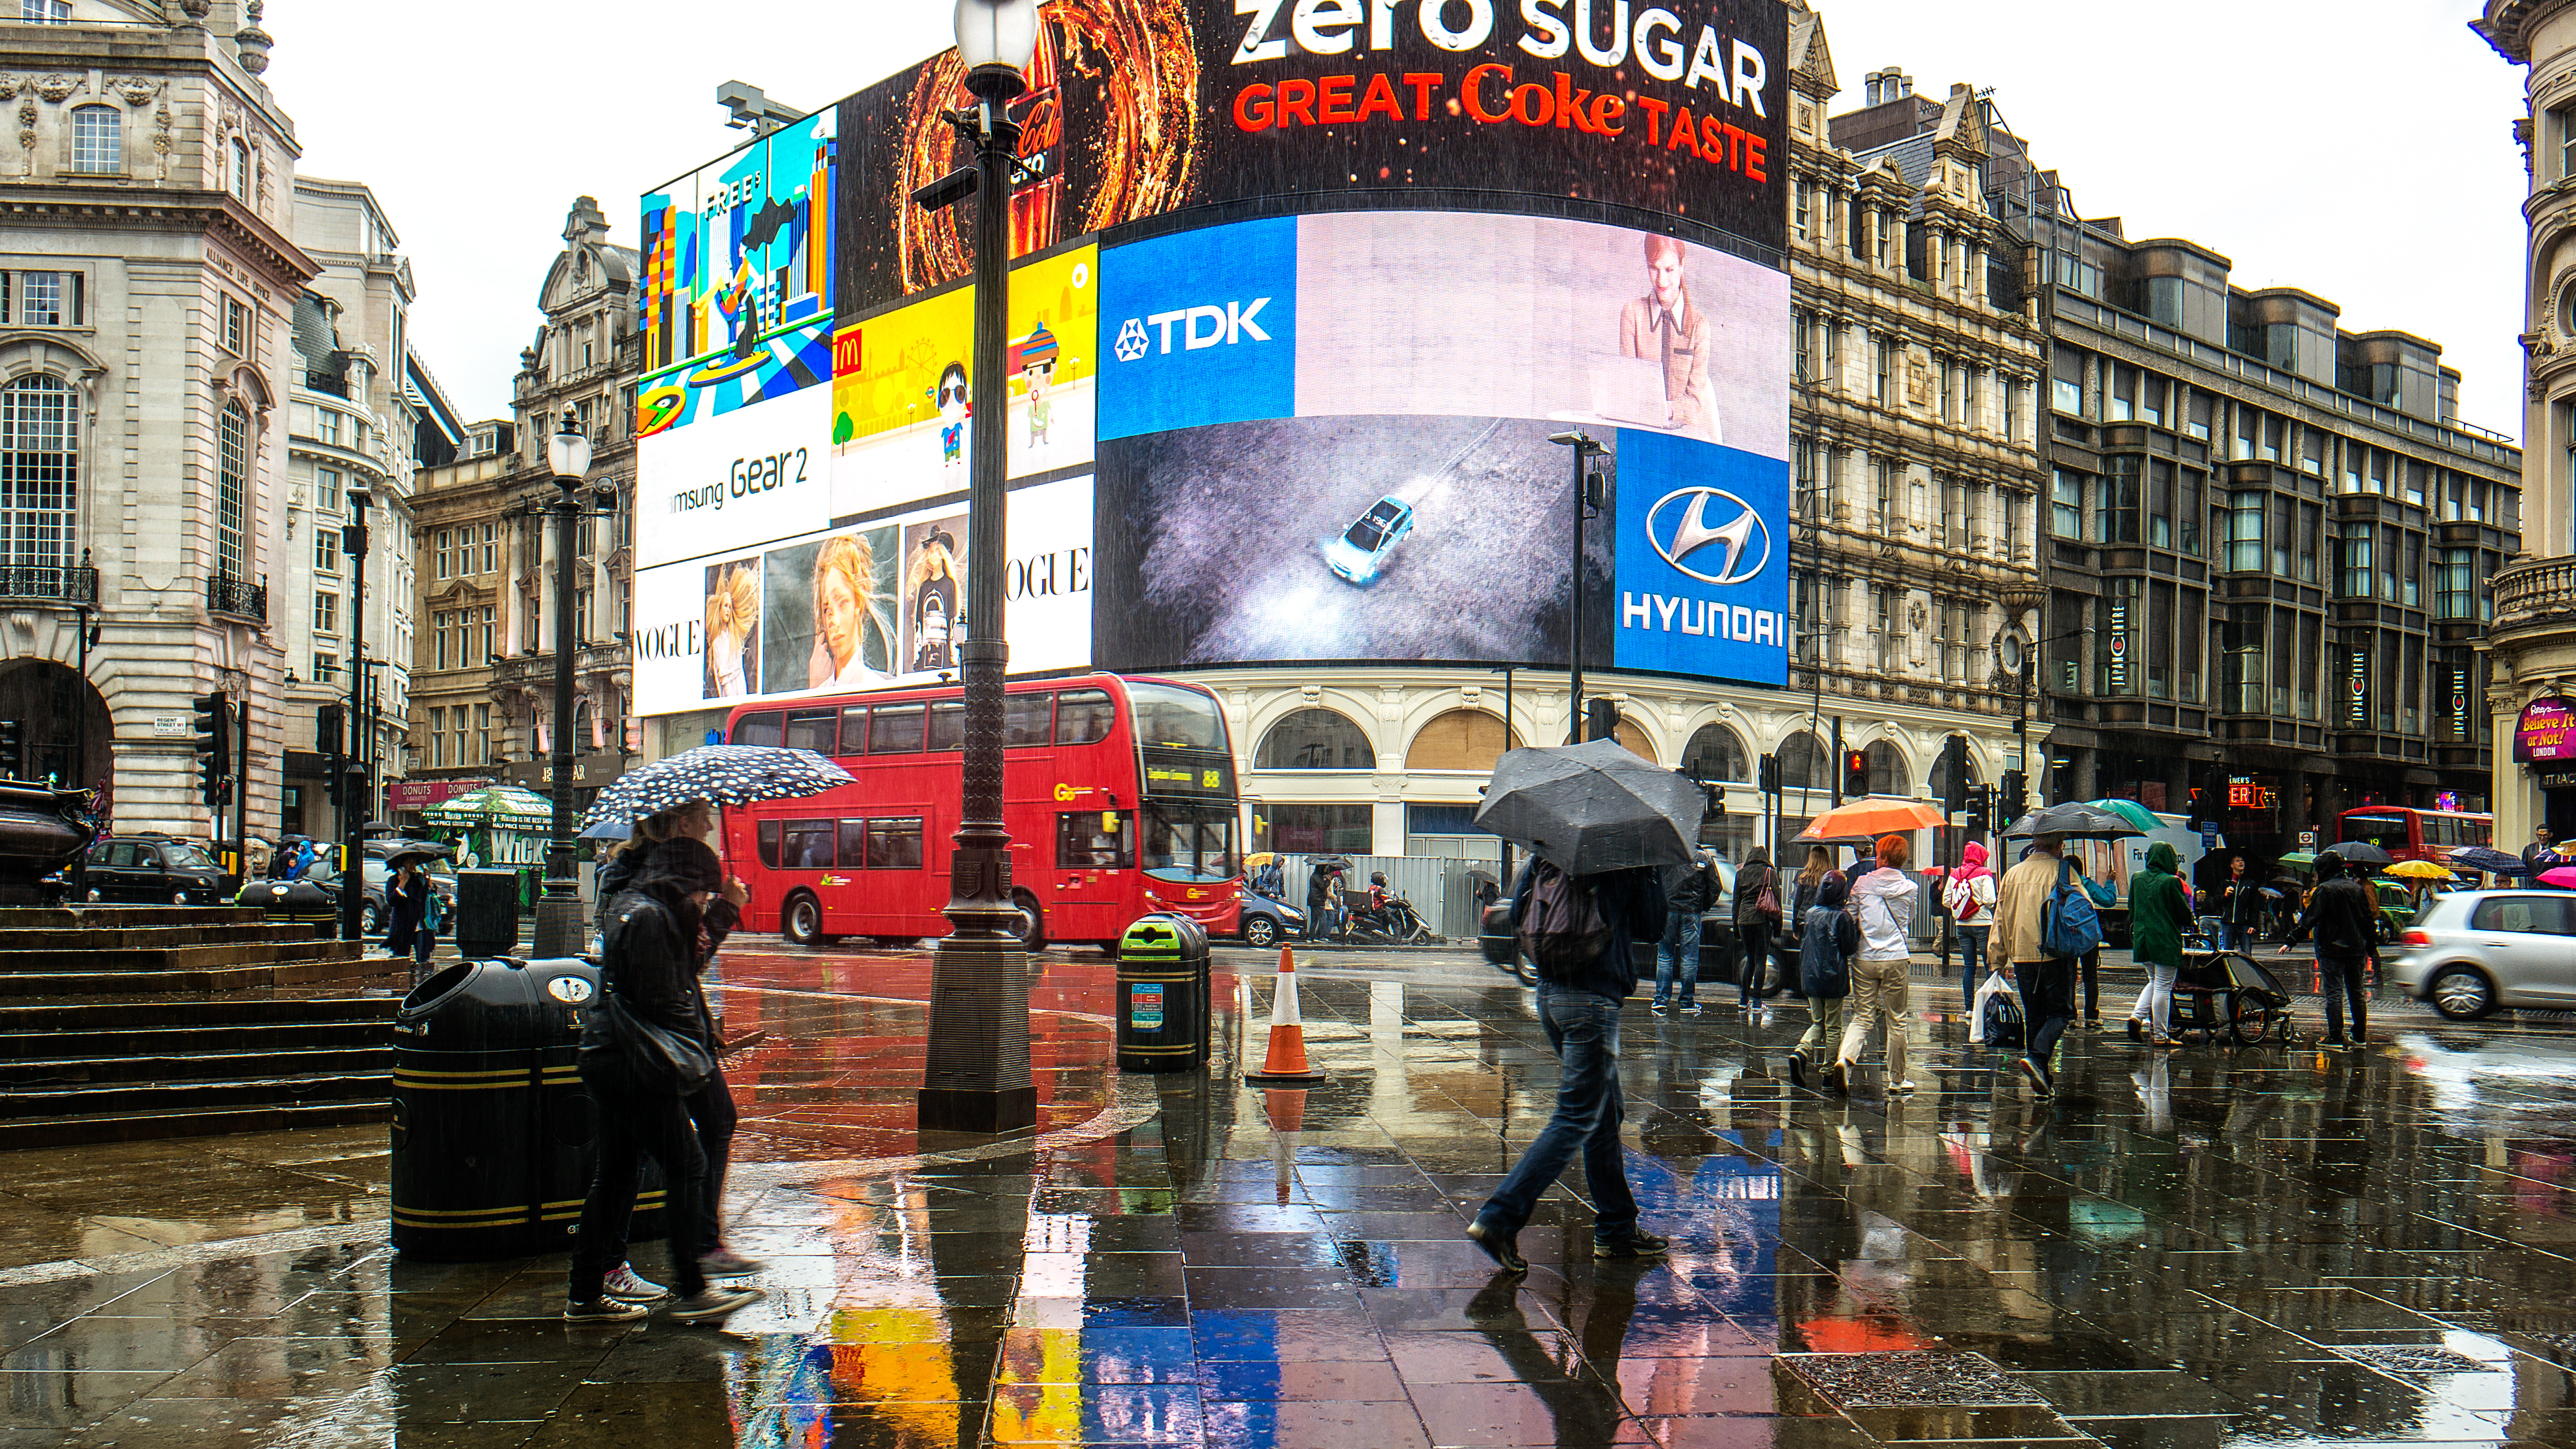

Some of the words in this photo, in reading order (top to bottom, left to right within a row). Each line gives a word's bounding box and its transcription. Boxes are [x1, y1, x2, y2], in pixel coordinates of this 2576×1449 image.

[1231, 0, 1494, 64] zero
[1517, 0, 1766, 118] SUGAR
[1018, 94, 1062, 158] Cola
[1233, 73, 1443, 132] GREAT
[1462, 64, 1625, 136] Coke
[1638, 96, 1766, 183] TASTE
[1010, 152, 1047, 184] ero
[206, 248, 233, 275] ALLIANCE
[237, 269, 249, 287] LIFE
[252, 281, 271, 302] OFFICE
[1147, 297, 1272, 354] TDK
[731, 451, 792, 498] Gear
[796, 447, 807, 483] 2
[1006, 547, 1088, 602] OGUE
[1624, 591, 1783, 647] HYUNDAI
[2110, 606, 2125, 657] CENTRE
[636, 620, 700, 661] VOGUE
[2111, 657, 2125, 685] JAPAN
[2351, 652, 2365, 695] CENTRE
[2452, 670, 2465, 711] CENTRE
[2352, 696, 2365, 721] JAPAN
[2454, 711, 2465, 734] JAPAN
[2523, 716, 2559, 732] Believe
[2561, 713, 2576, 728] It
[2528, 736, 2538, 747] or
[2539, 729, 2565, 746] Not!
[2533, 747, 2556, 757] LONDON
[402, 785, 431, 796] DONUTS
[448, 783, 477, 794] DONUTS
[1203, 770, 1220, 788] 88
[2542, 773, 2576, 785] ATTRAC
[2229, 787, 2249, 804] ER
[2133, 848, 2143, 861] Fix
[2370, 838, 2379, 846] 19
